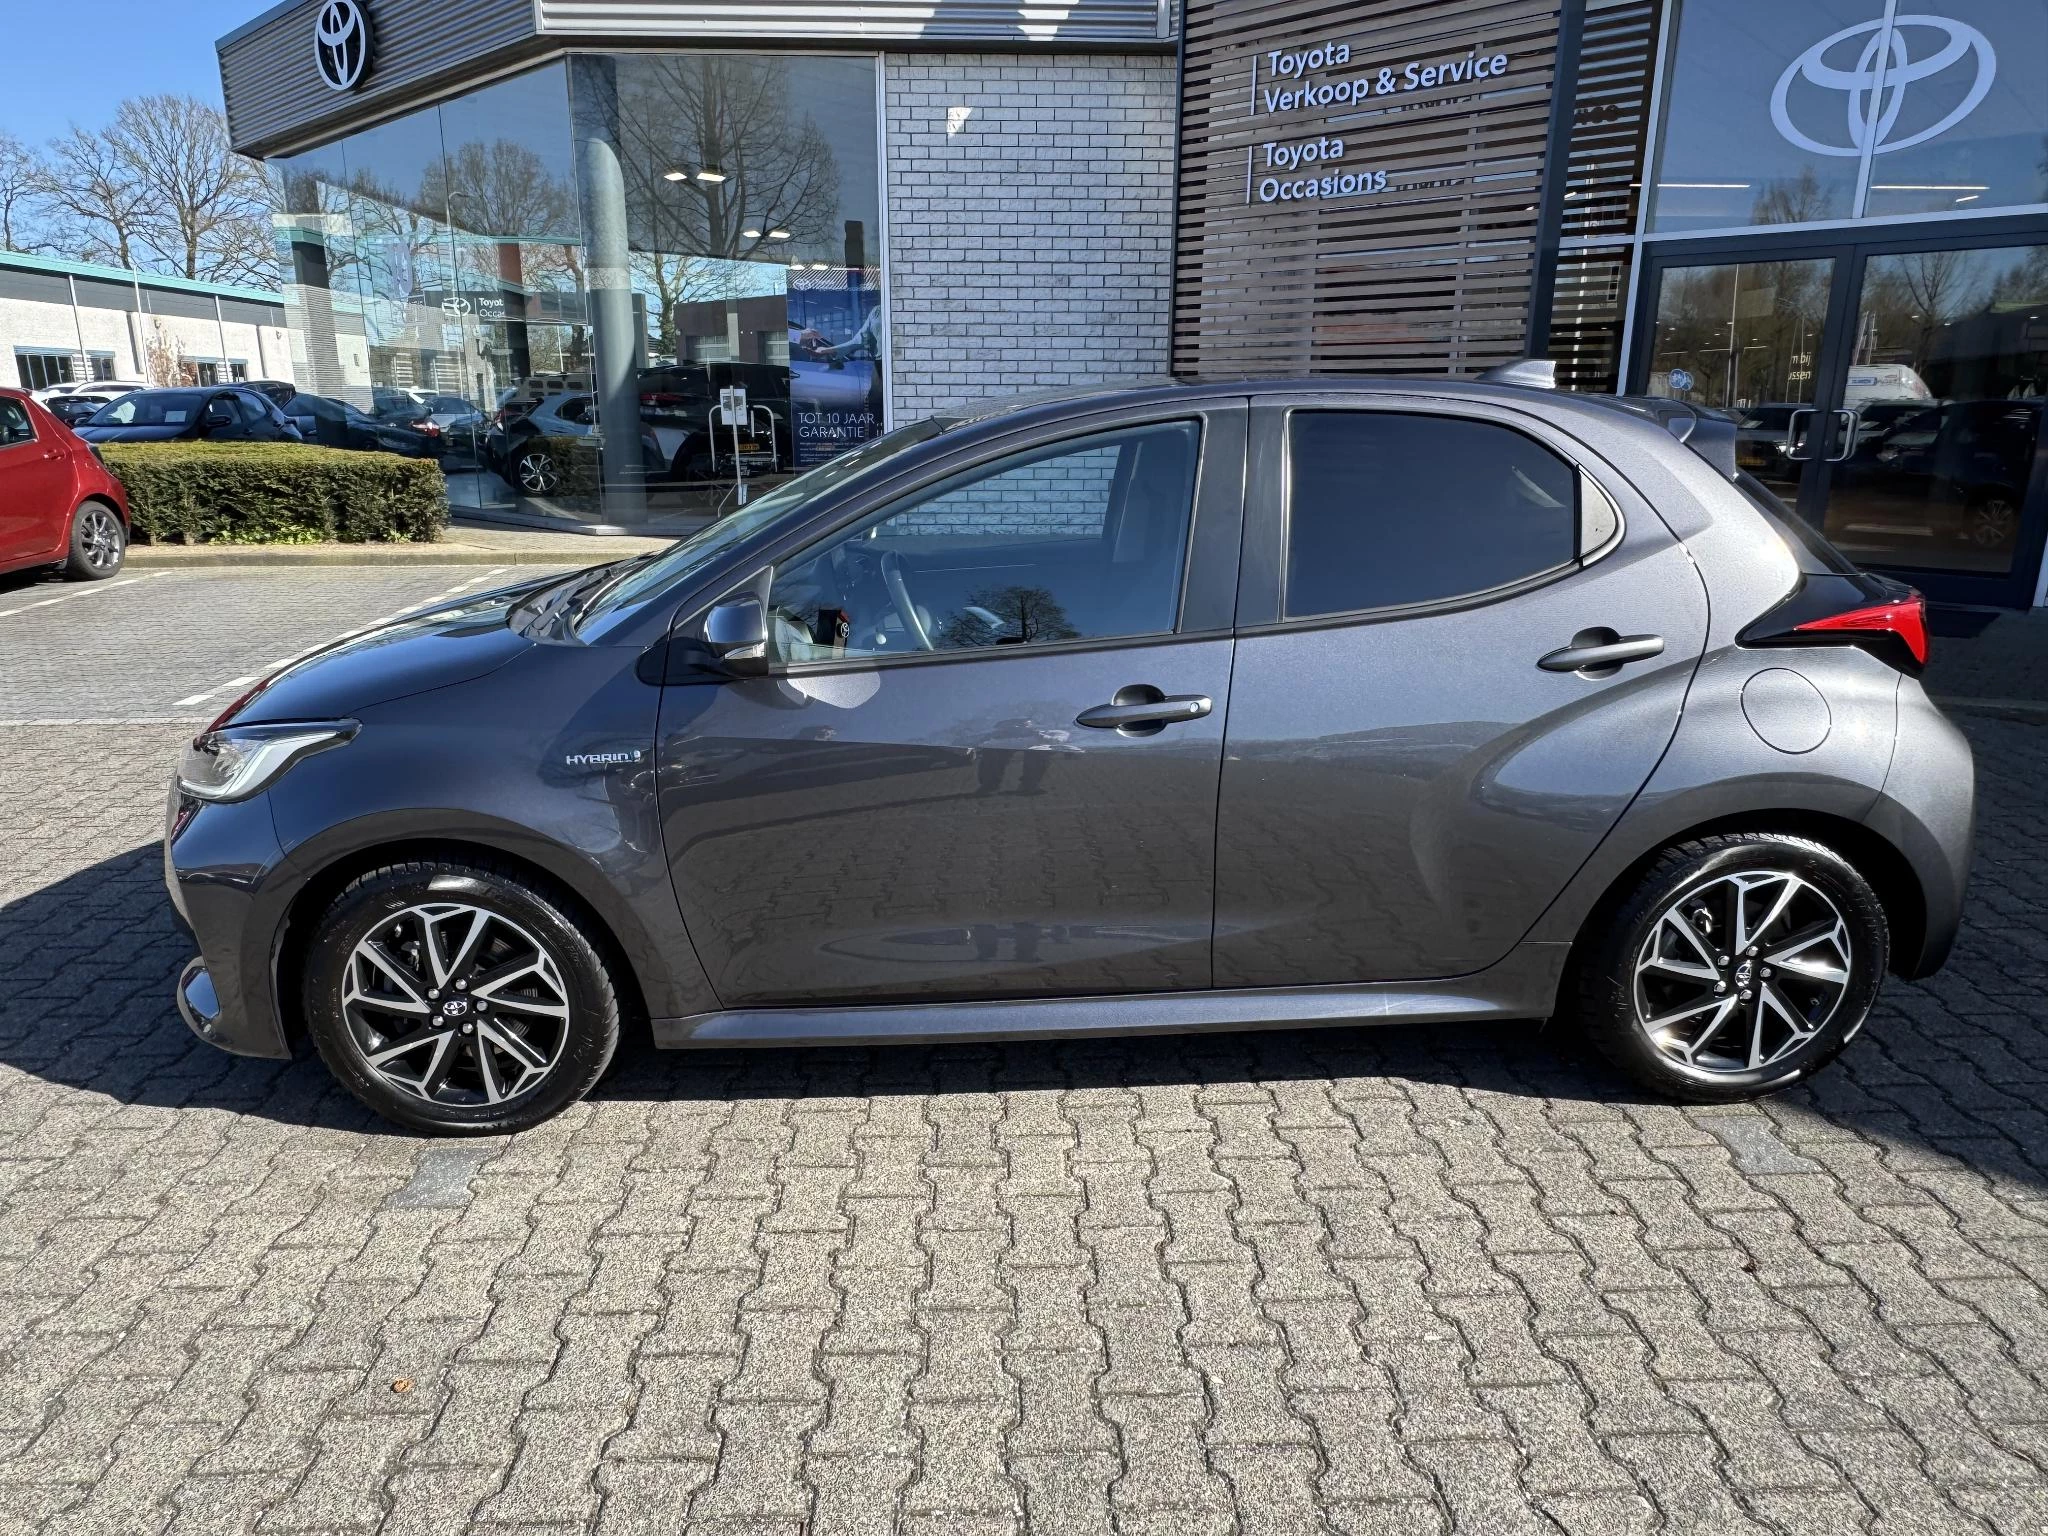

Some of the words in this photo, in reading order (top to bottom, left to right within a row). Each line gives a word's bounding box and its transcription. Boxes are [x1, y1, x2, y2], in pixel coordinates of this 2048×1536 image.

[1267, 41, 1350, 79] Toyota
[1264, 78, 1369, 113] Verkoop
[1375, 68, 1396, 95] &
[1403, 51, 1508, 90] Service
[1262, 137, 1344, 170] Toyota
[1259, 169, 1387, 202] Occasions
[1800, 351, 1811, 366] bij
[798, 412, 822, 424] TOT
[827, 412, 840, 424] 10
[844, 413, 875, 424] JAAR
[799, 426, 864, 438] GARANTIE
